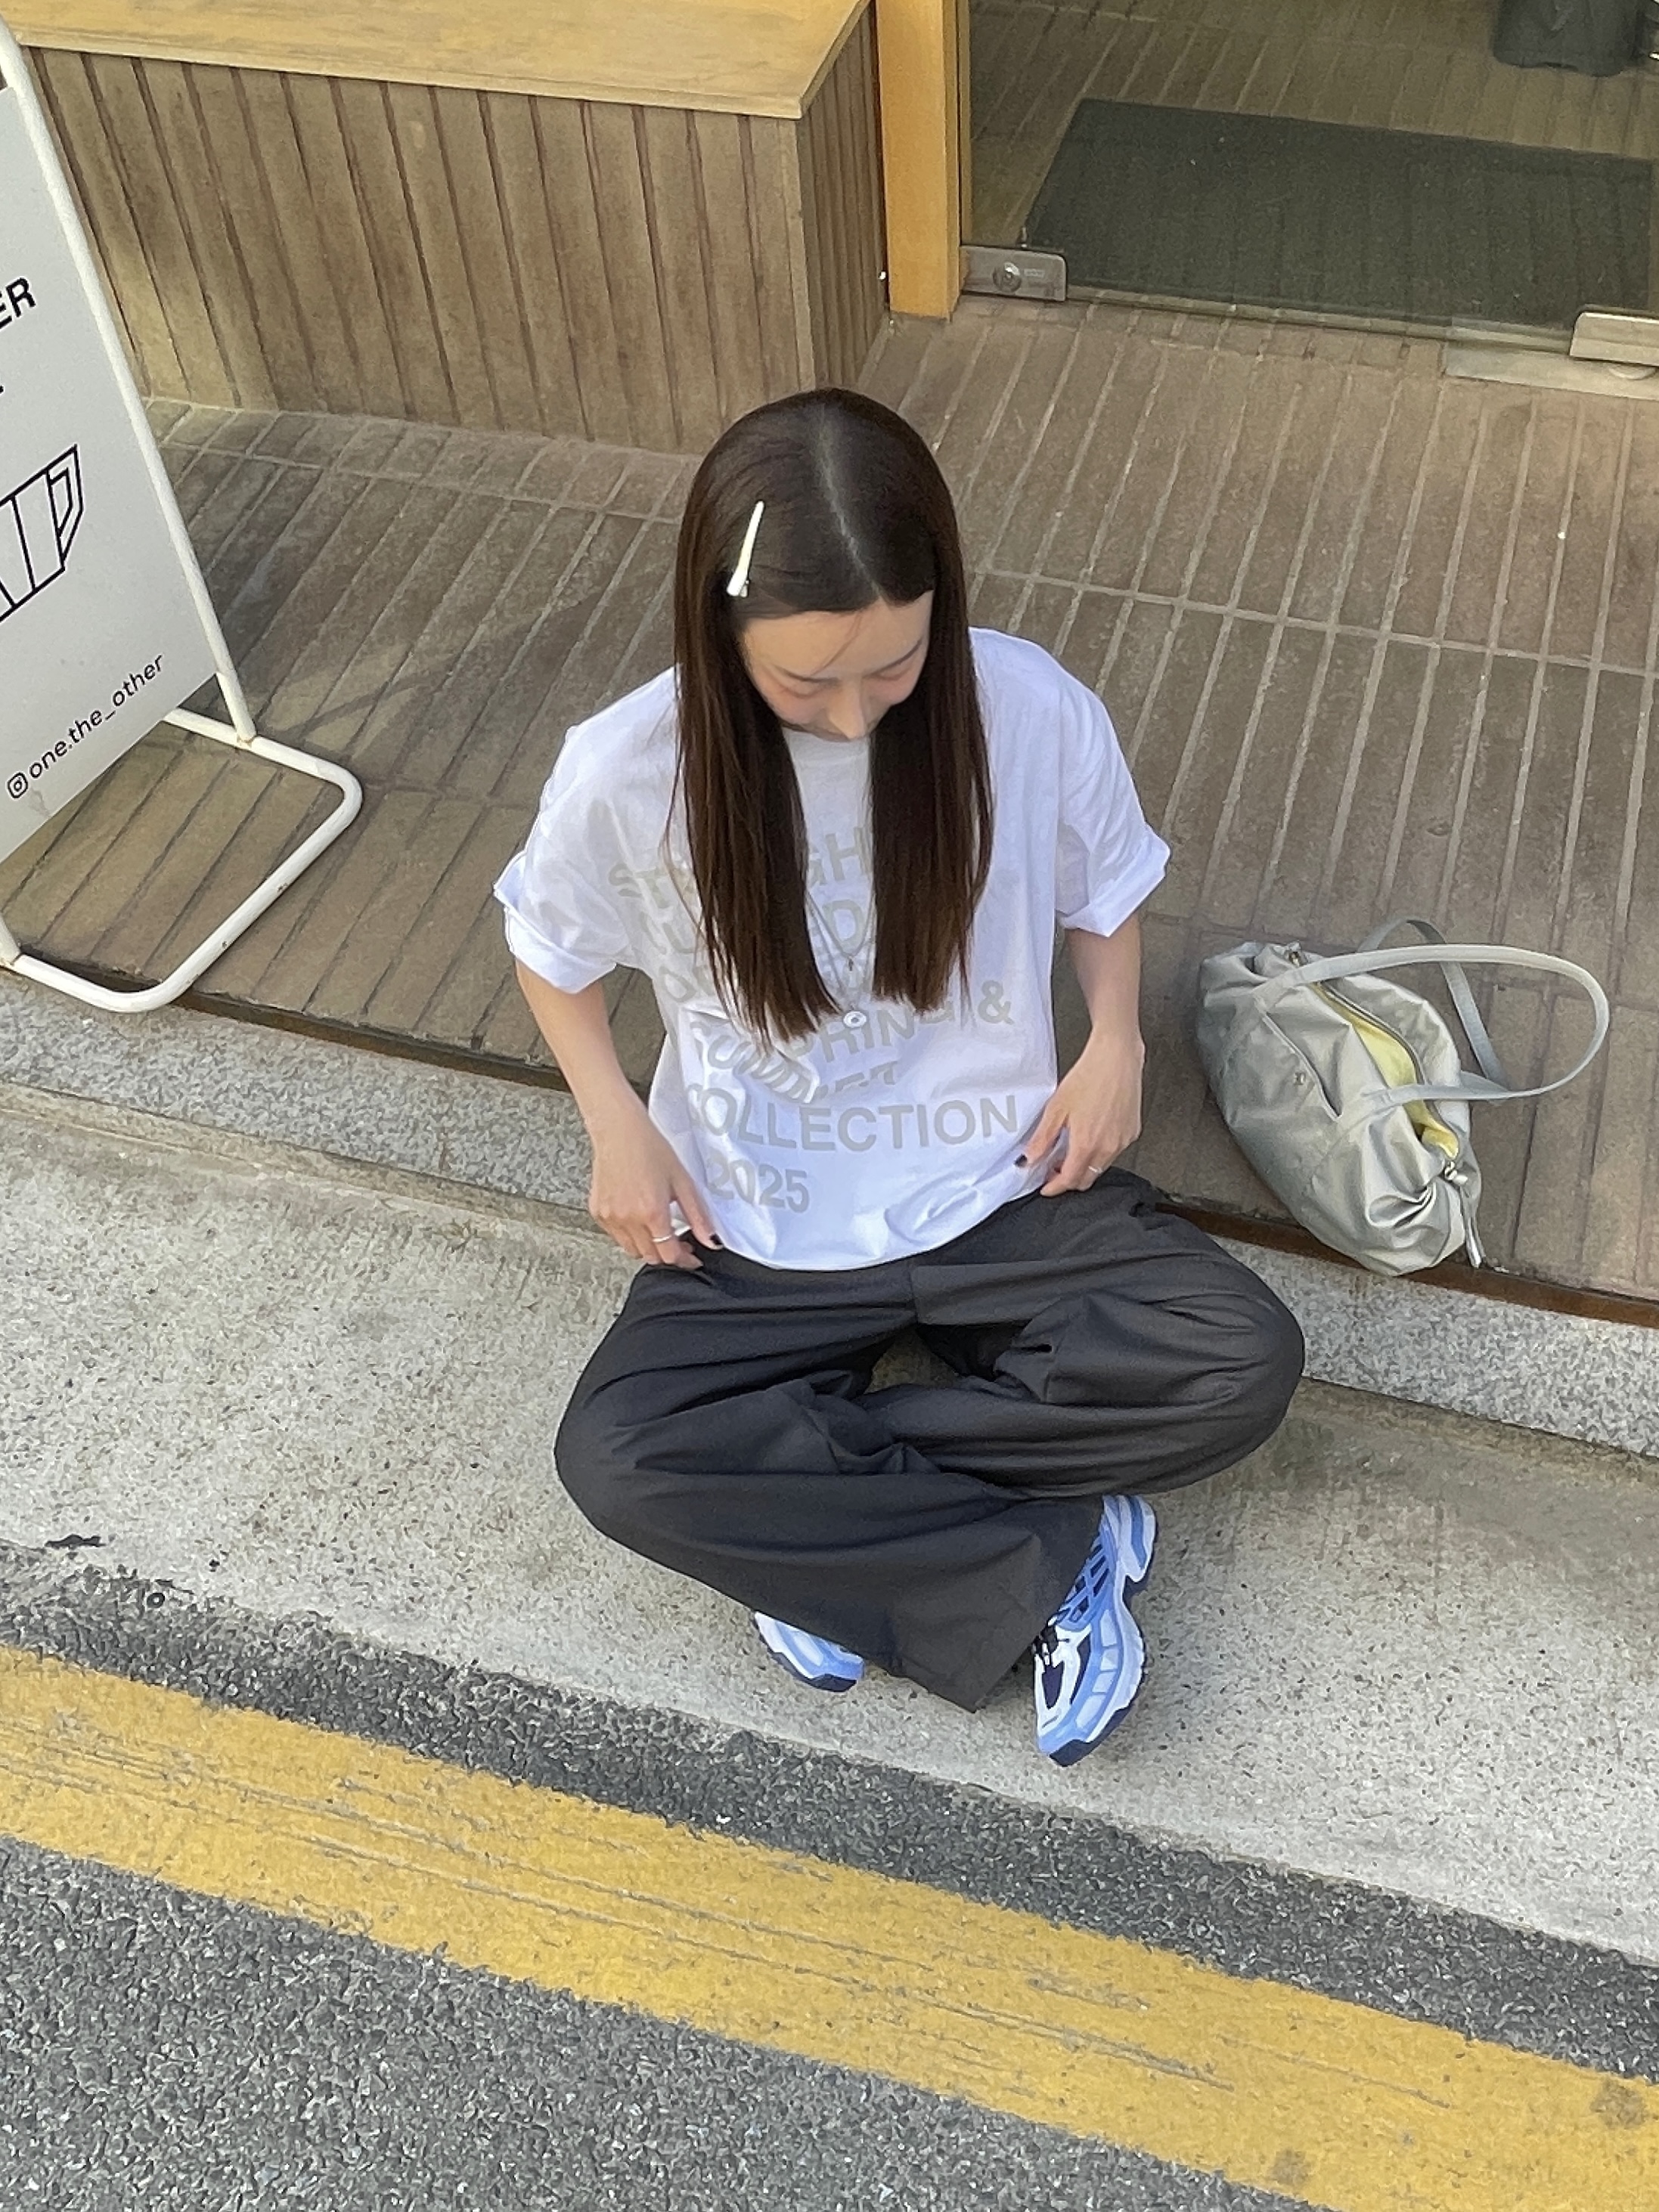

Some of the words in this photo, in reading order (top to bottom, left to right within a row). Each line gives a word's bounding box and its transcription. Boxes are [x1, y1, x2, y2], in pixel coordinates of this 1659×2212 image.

[29, 654, 163, 779] one.the_other
[977, 980, 1016, 1026] &
[706, 1146, 811, 1213] 2025
